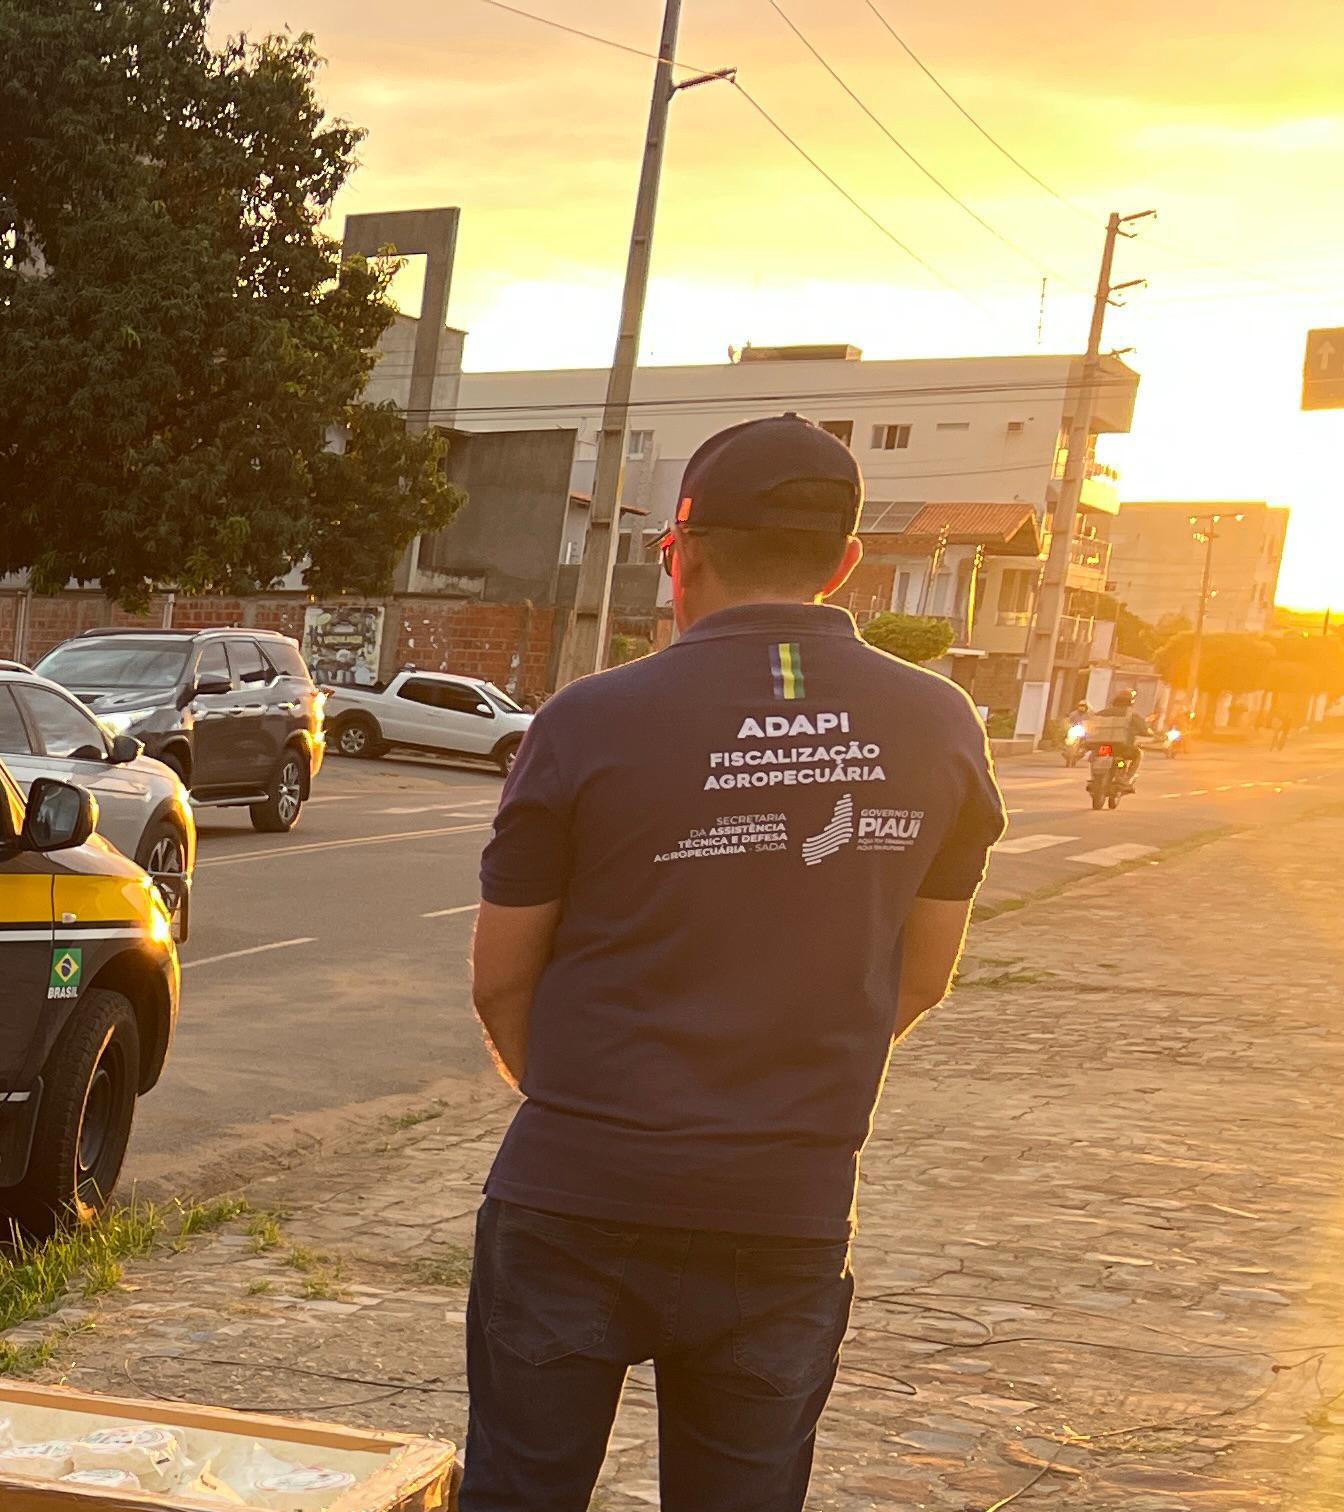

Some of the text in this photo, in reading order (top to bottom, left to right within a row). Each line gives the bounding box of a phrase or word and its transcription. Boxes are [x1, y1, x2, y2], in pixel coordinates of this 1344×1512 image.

[737, 712, 850, 739] ADAPI
[710, 741, 880, 768] FISCALIZAÇÃO
[704, 764, 886, 790] AGROPECUÁRIA
[716, 813, 787, 826] SECRETARIA
[861, 809, 908, 818] GOVERNO
[689, 822, 786, 838] DA ASSISTÊNCIA
[678, 832, 788, 848] TÉCNICA E DEFESA
[654, 845, 746, 862] AGROPECUÁRIA
[755, 842, 787, 852] SADA
[48, 986, 78, 999] BRASIL
